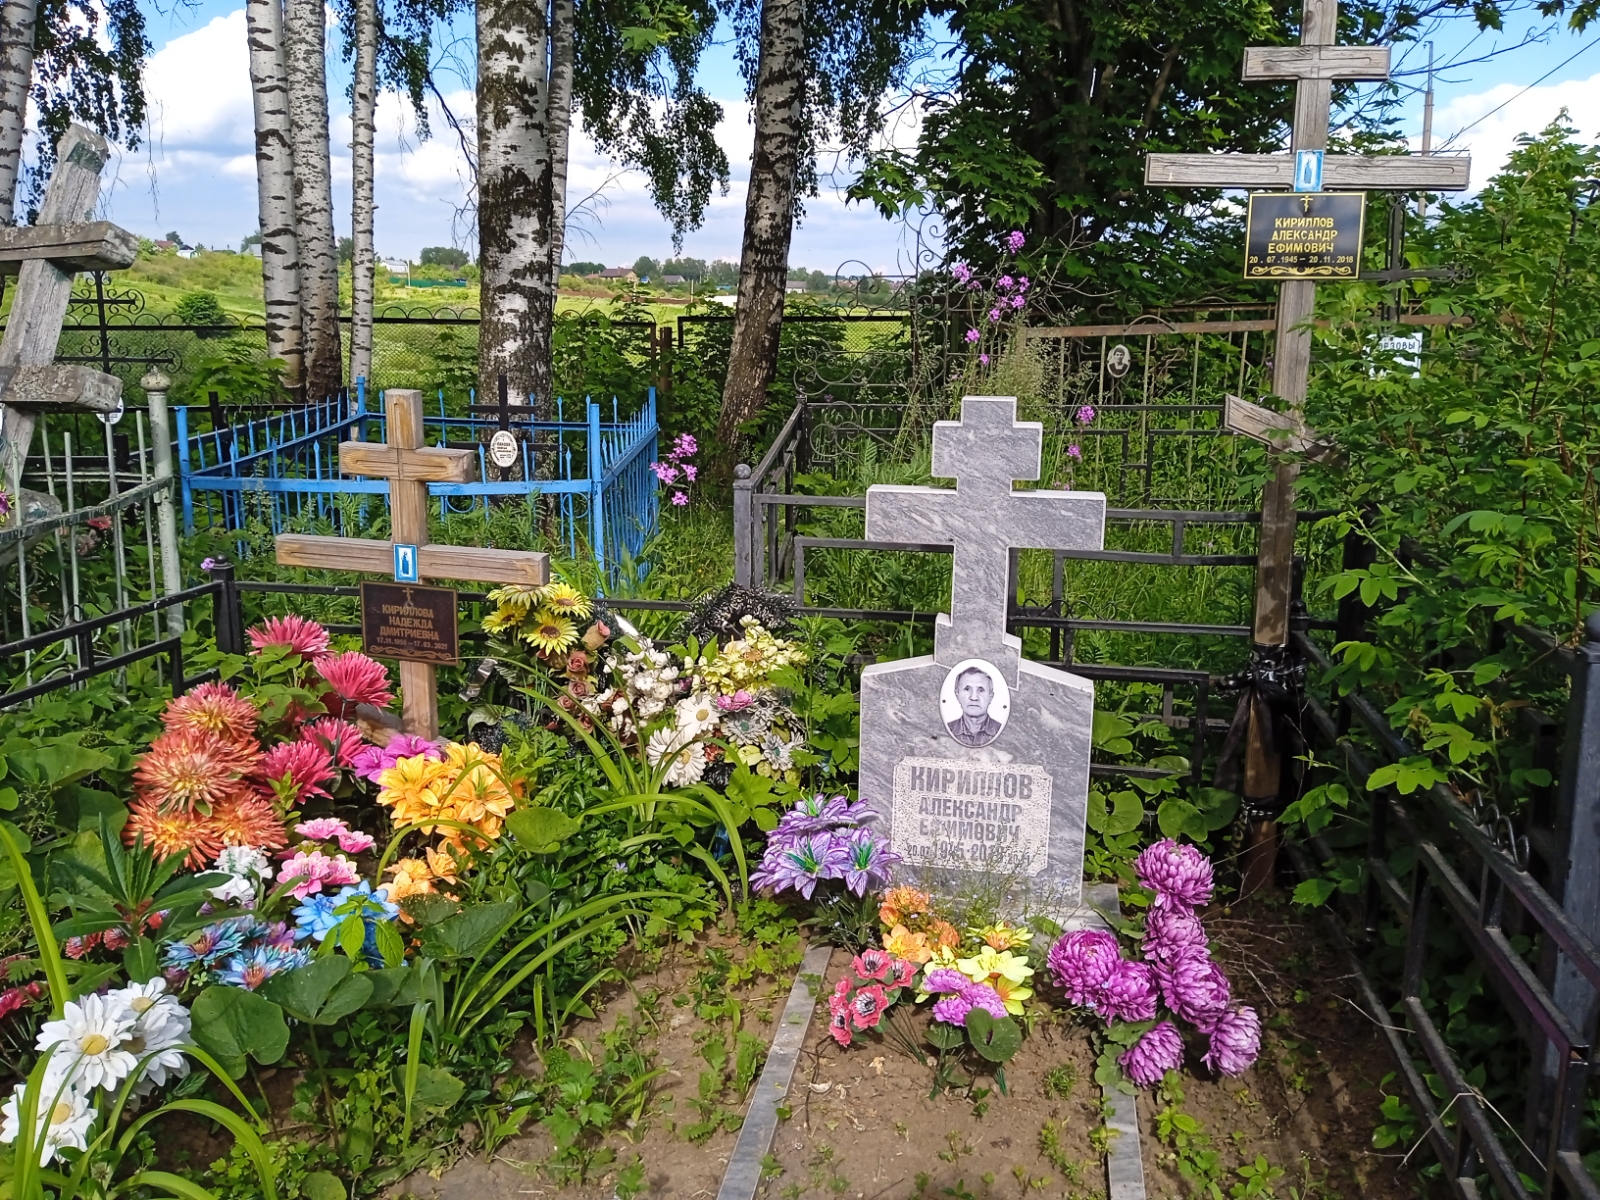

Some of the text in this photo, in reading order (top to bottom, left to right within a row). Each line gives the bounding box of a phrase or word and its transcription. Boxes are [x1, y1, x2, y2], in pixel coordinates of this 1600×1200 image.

[1275, 217, 1334, 228] КИРИЛЛОВ
[1271, 230, 1338, 241] АЛЕКСАНДР
[1268, 243, 1334, 254] ЕФИМОВИЧ
[382, 604, 434, 618] КИРИЛЛОВА
[388, 616, 433, 629] НАДЕЖДА
[380, 626, 439, 640] ДМИТРИЕВНА
[910, 765, 1033, 800] КИРИЛЛОВ
[918, 796, 1023, 823] АЛЕКСАНДР
